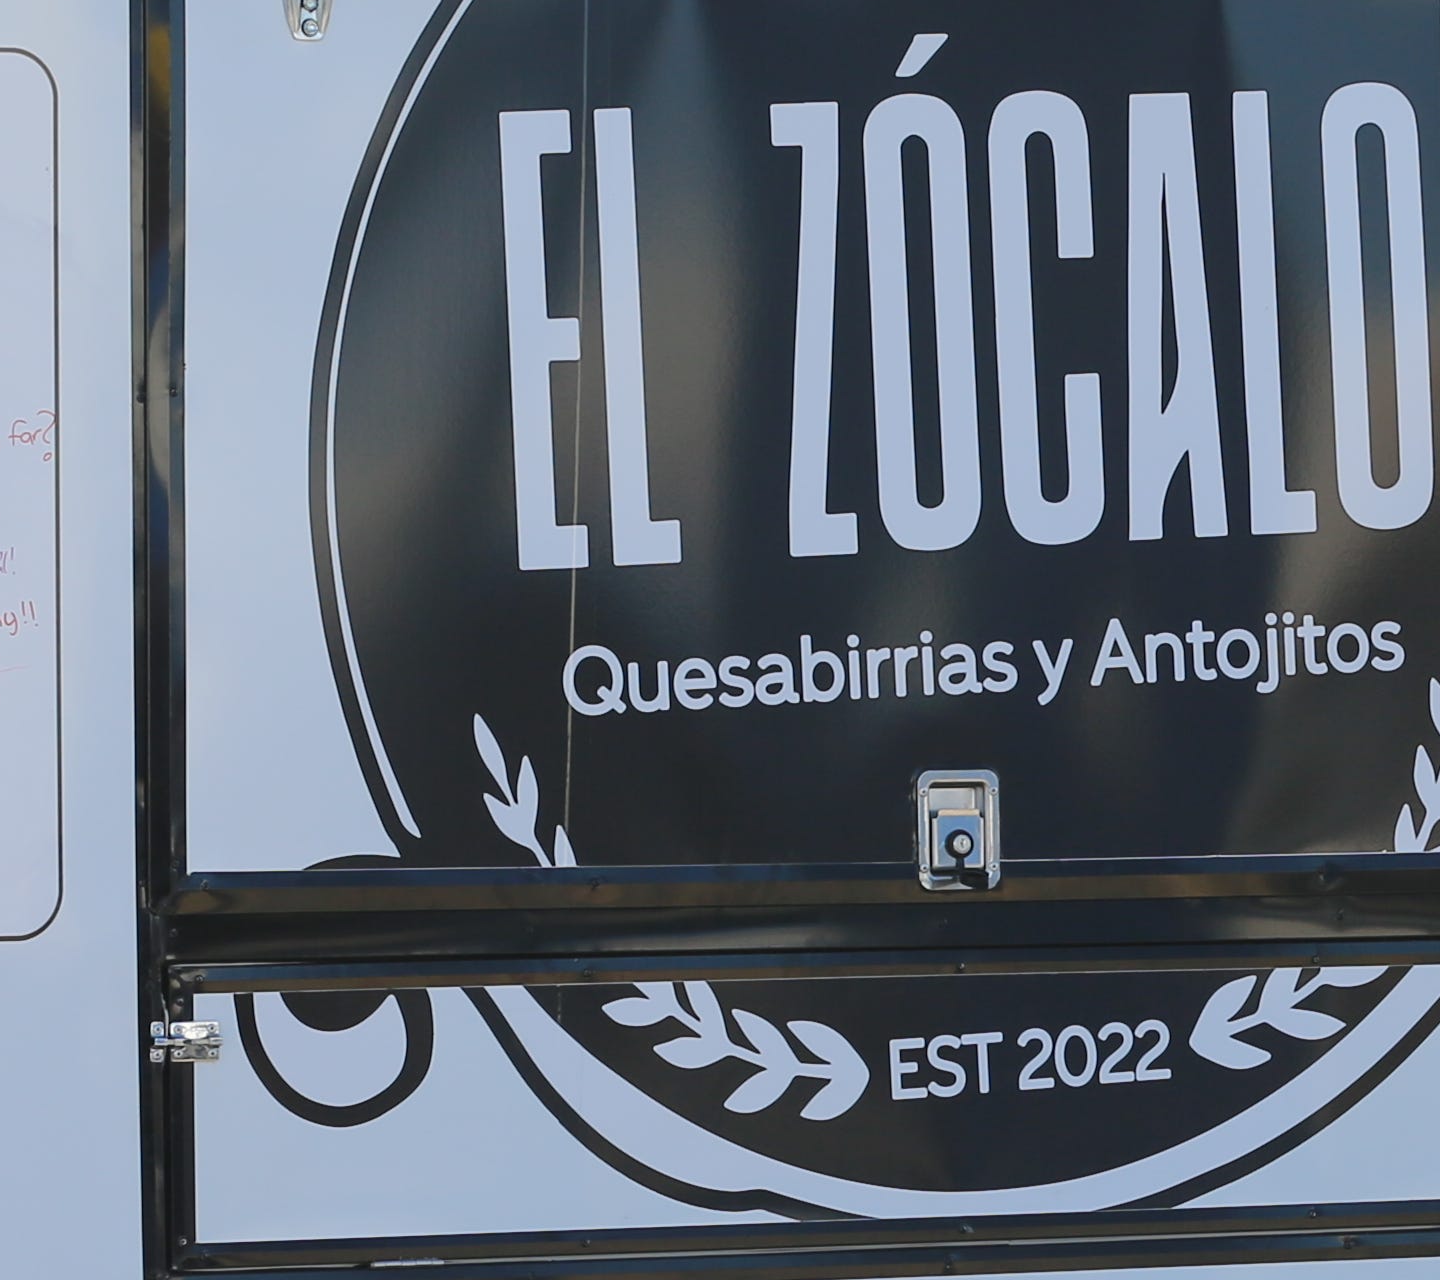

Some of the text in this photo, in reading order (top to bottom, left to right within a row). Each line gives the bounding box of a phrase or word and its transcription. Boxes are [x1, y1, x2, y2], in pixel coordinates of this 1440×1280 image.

[498, 34, 1436, 571] EL ZÓCALO
[561, 618, 1405, 716] Quesabirrias y Antojitos
[891, 1021, 1172, 1101] EST 2022
